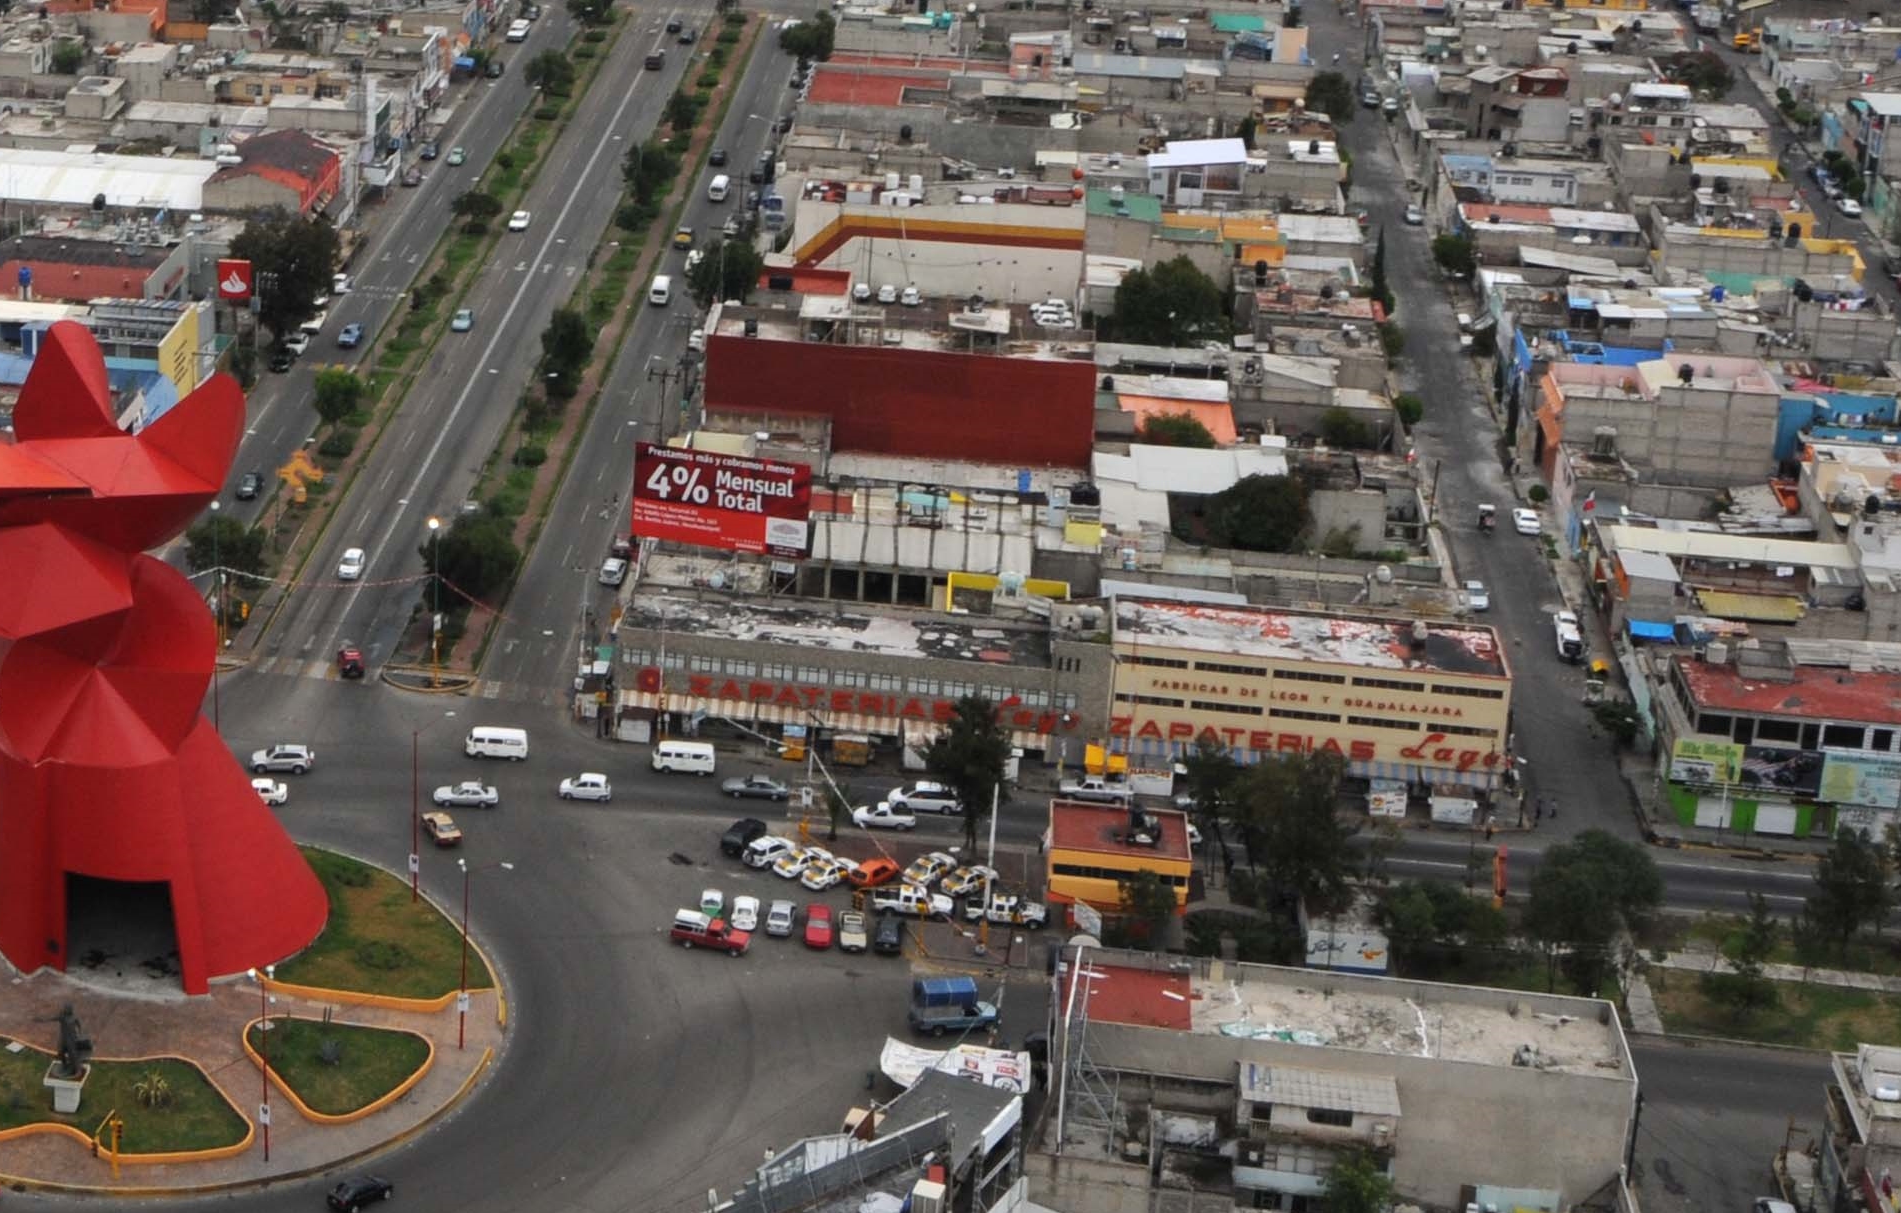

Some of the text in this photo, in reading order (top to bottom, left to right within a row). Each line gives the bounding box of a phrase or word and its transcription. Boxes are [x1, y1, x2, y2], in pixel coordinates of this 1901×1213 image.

[647, 463, 710, 504] 4%
[714, 457, 721, 466] y
[722, 458, 763, 470] cobramos
[766, 463, 796, 475] menos
[715, 470, 794, 498] Mensual
[715, 489, 763, 513] Total
[689, 675, 959, 721] ZAPATERIAS
[1152, 679, 1464, 718] FABRICAS DE LEON Y GUADALAJARA
[1109, 715, 1501, 773] ZAPATERIAS Lago
